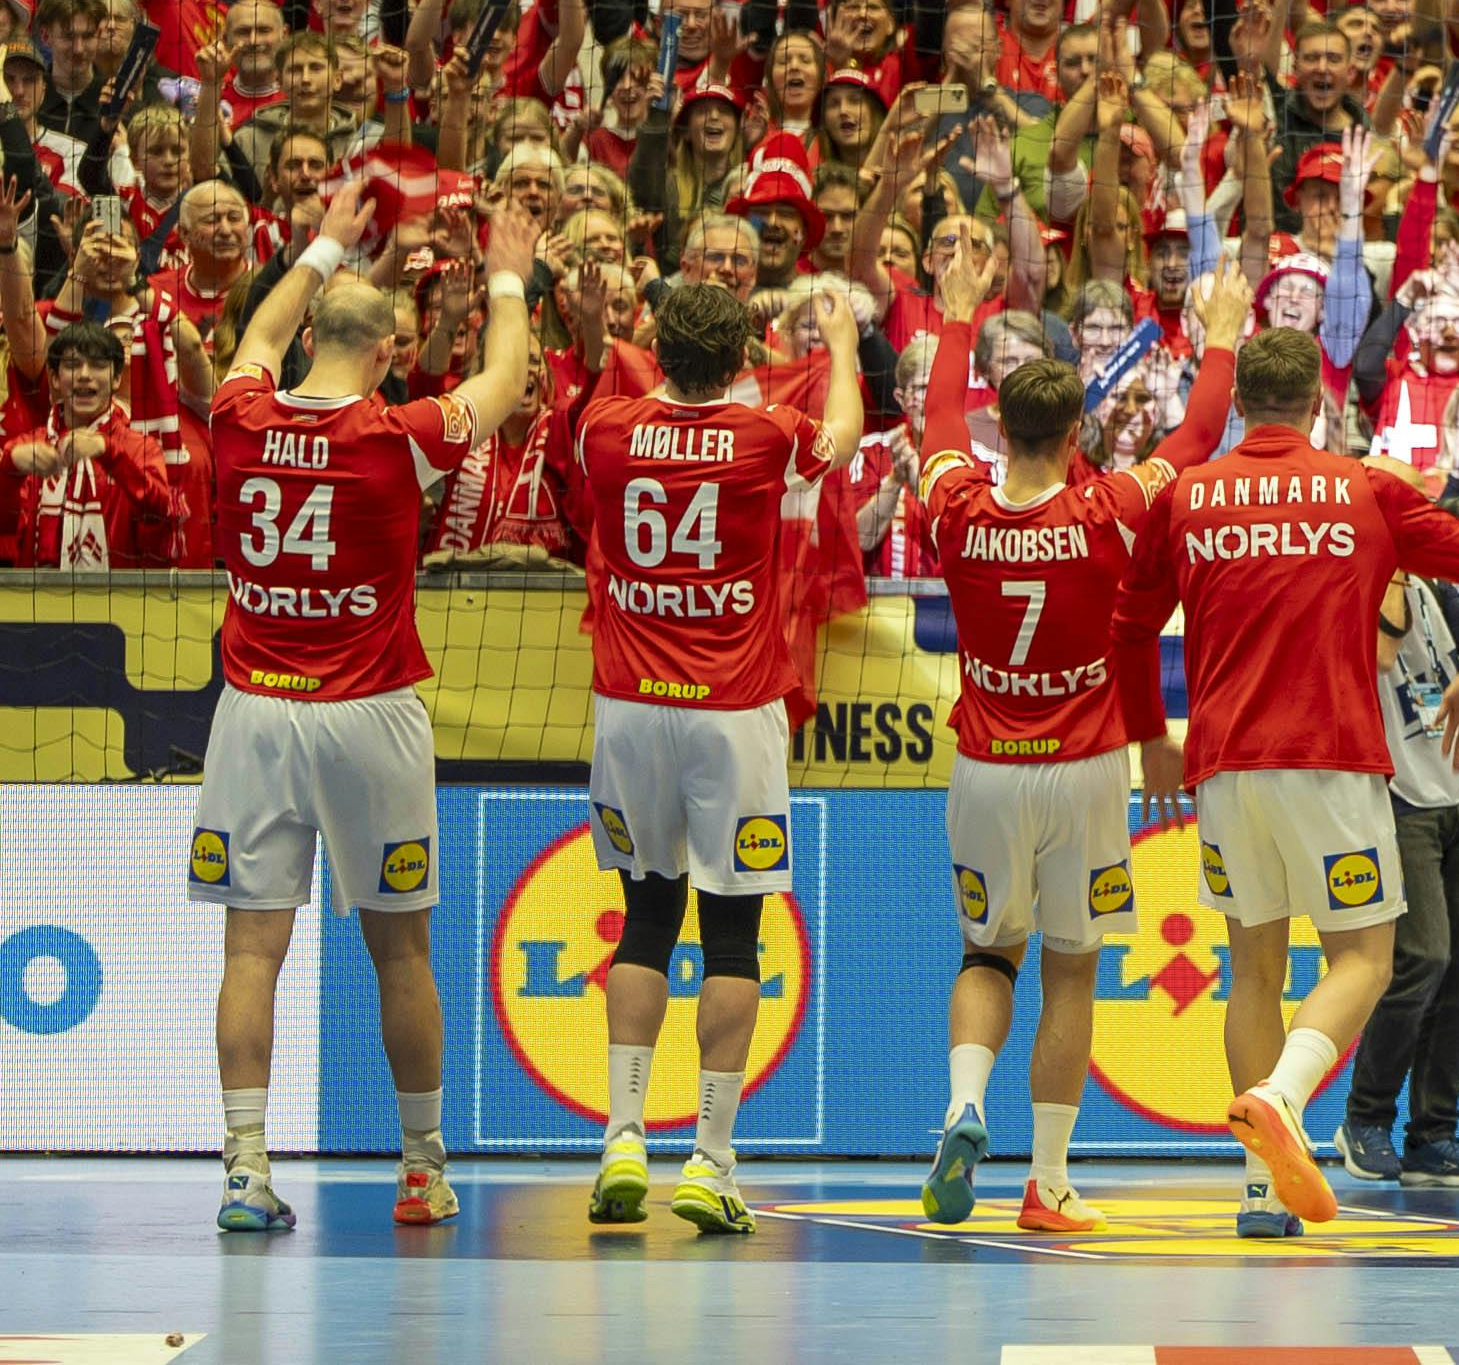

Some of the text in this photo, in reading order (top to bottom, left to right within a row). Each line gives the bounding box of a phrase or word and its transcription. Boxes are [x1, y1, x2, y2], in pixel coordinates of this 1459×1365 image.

[262, 429, 330, 470] HALD
[629, 424, 735, 463] MØLLER
[438, 438, 494, 557] DANMAR
[1189, 474, 1352, 512] DANMARK
[239, 476, 337, 572] 34
[623, 477, 723, 570] 64
[961, 524, 1089, 564] JAKOBSEN
[1185, 520, 1356, 565] NORLYS
[608, 574, 756, 618] NORLYS
[1001, 580, 1047, 666] 7
[250, 669, 322, 692] BORUP
[638, 678, 711, 700] BORUP
[991, 738, 1062, 756] BORUP
